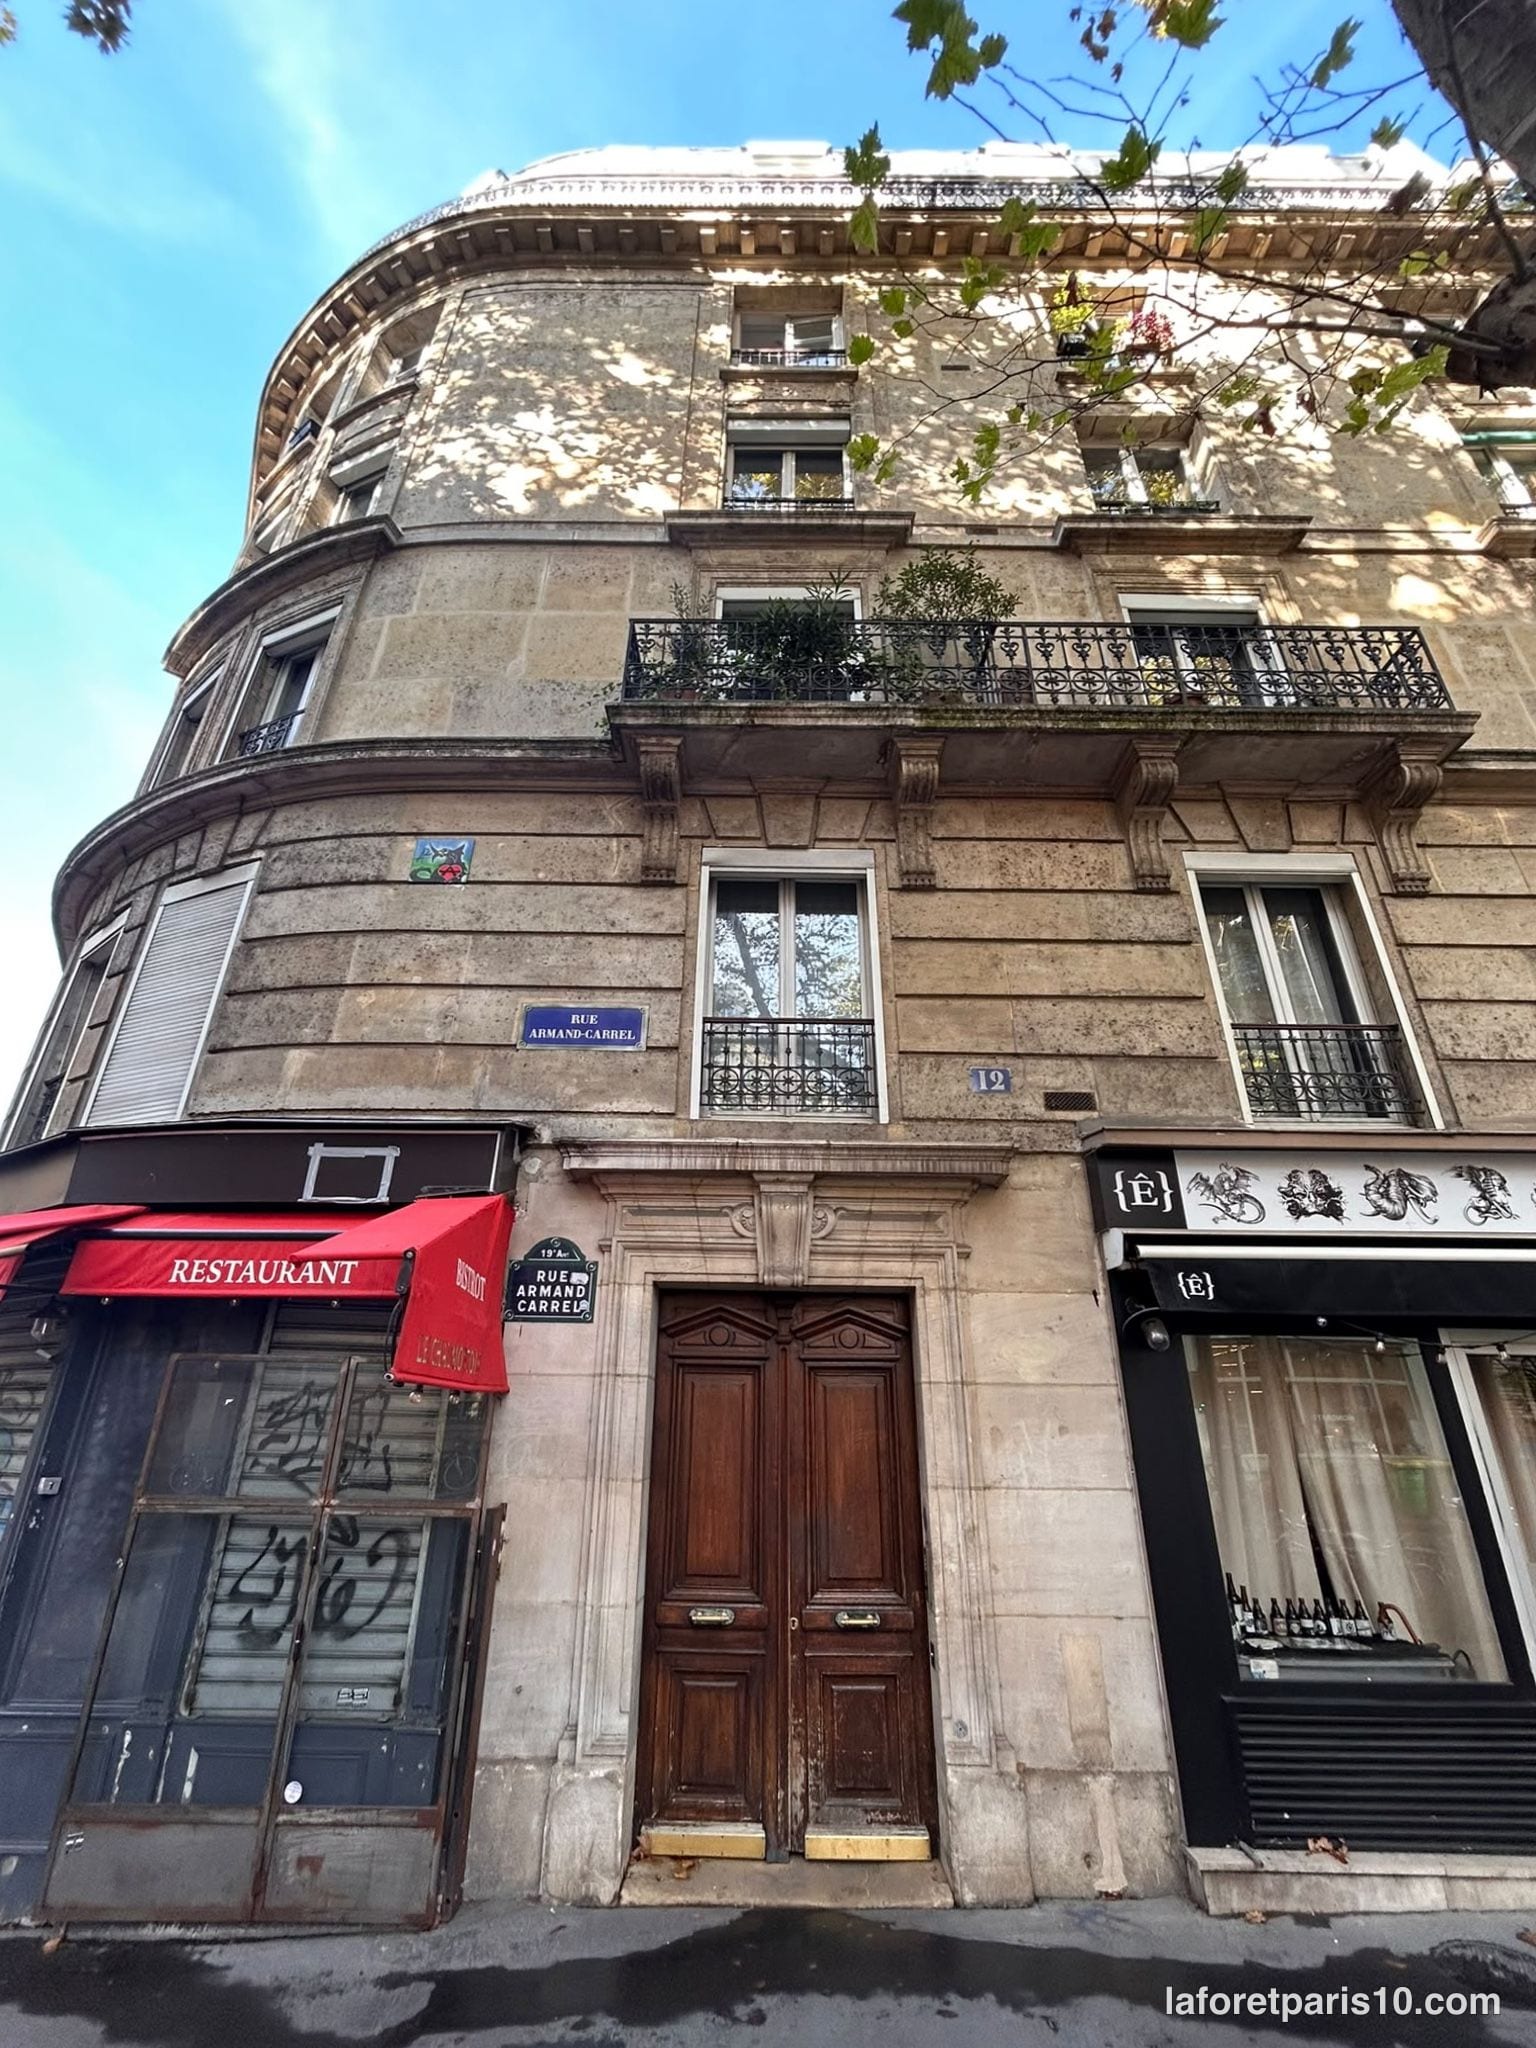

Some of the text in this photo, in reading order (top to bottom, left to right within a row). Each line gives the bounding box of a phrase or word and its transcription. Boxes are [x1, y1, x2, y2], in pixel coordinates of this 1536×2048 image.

[570, 1014, 599, 1025] RUE
[529, 1028, 636, 1040] ARMAND-CARREL
[978, 1070, 1006, 1091] 12
[168, 1258, 359, 1284] RESTAURANT
[536, 1270, 569, 1283] RUE
[456, 1258, 487, 1302] BISTROT
[516, 1284, 586, 1298] ARMAND
[517, 1299, 581, 1313] CARREL
